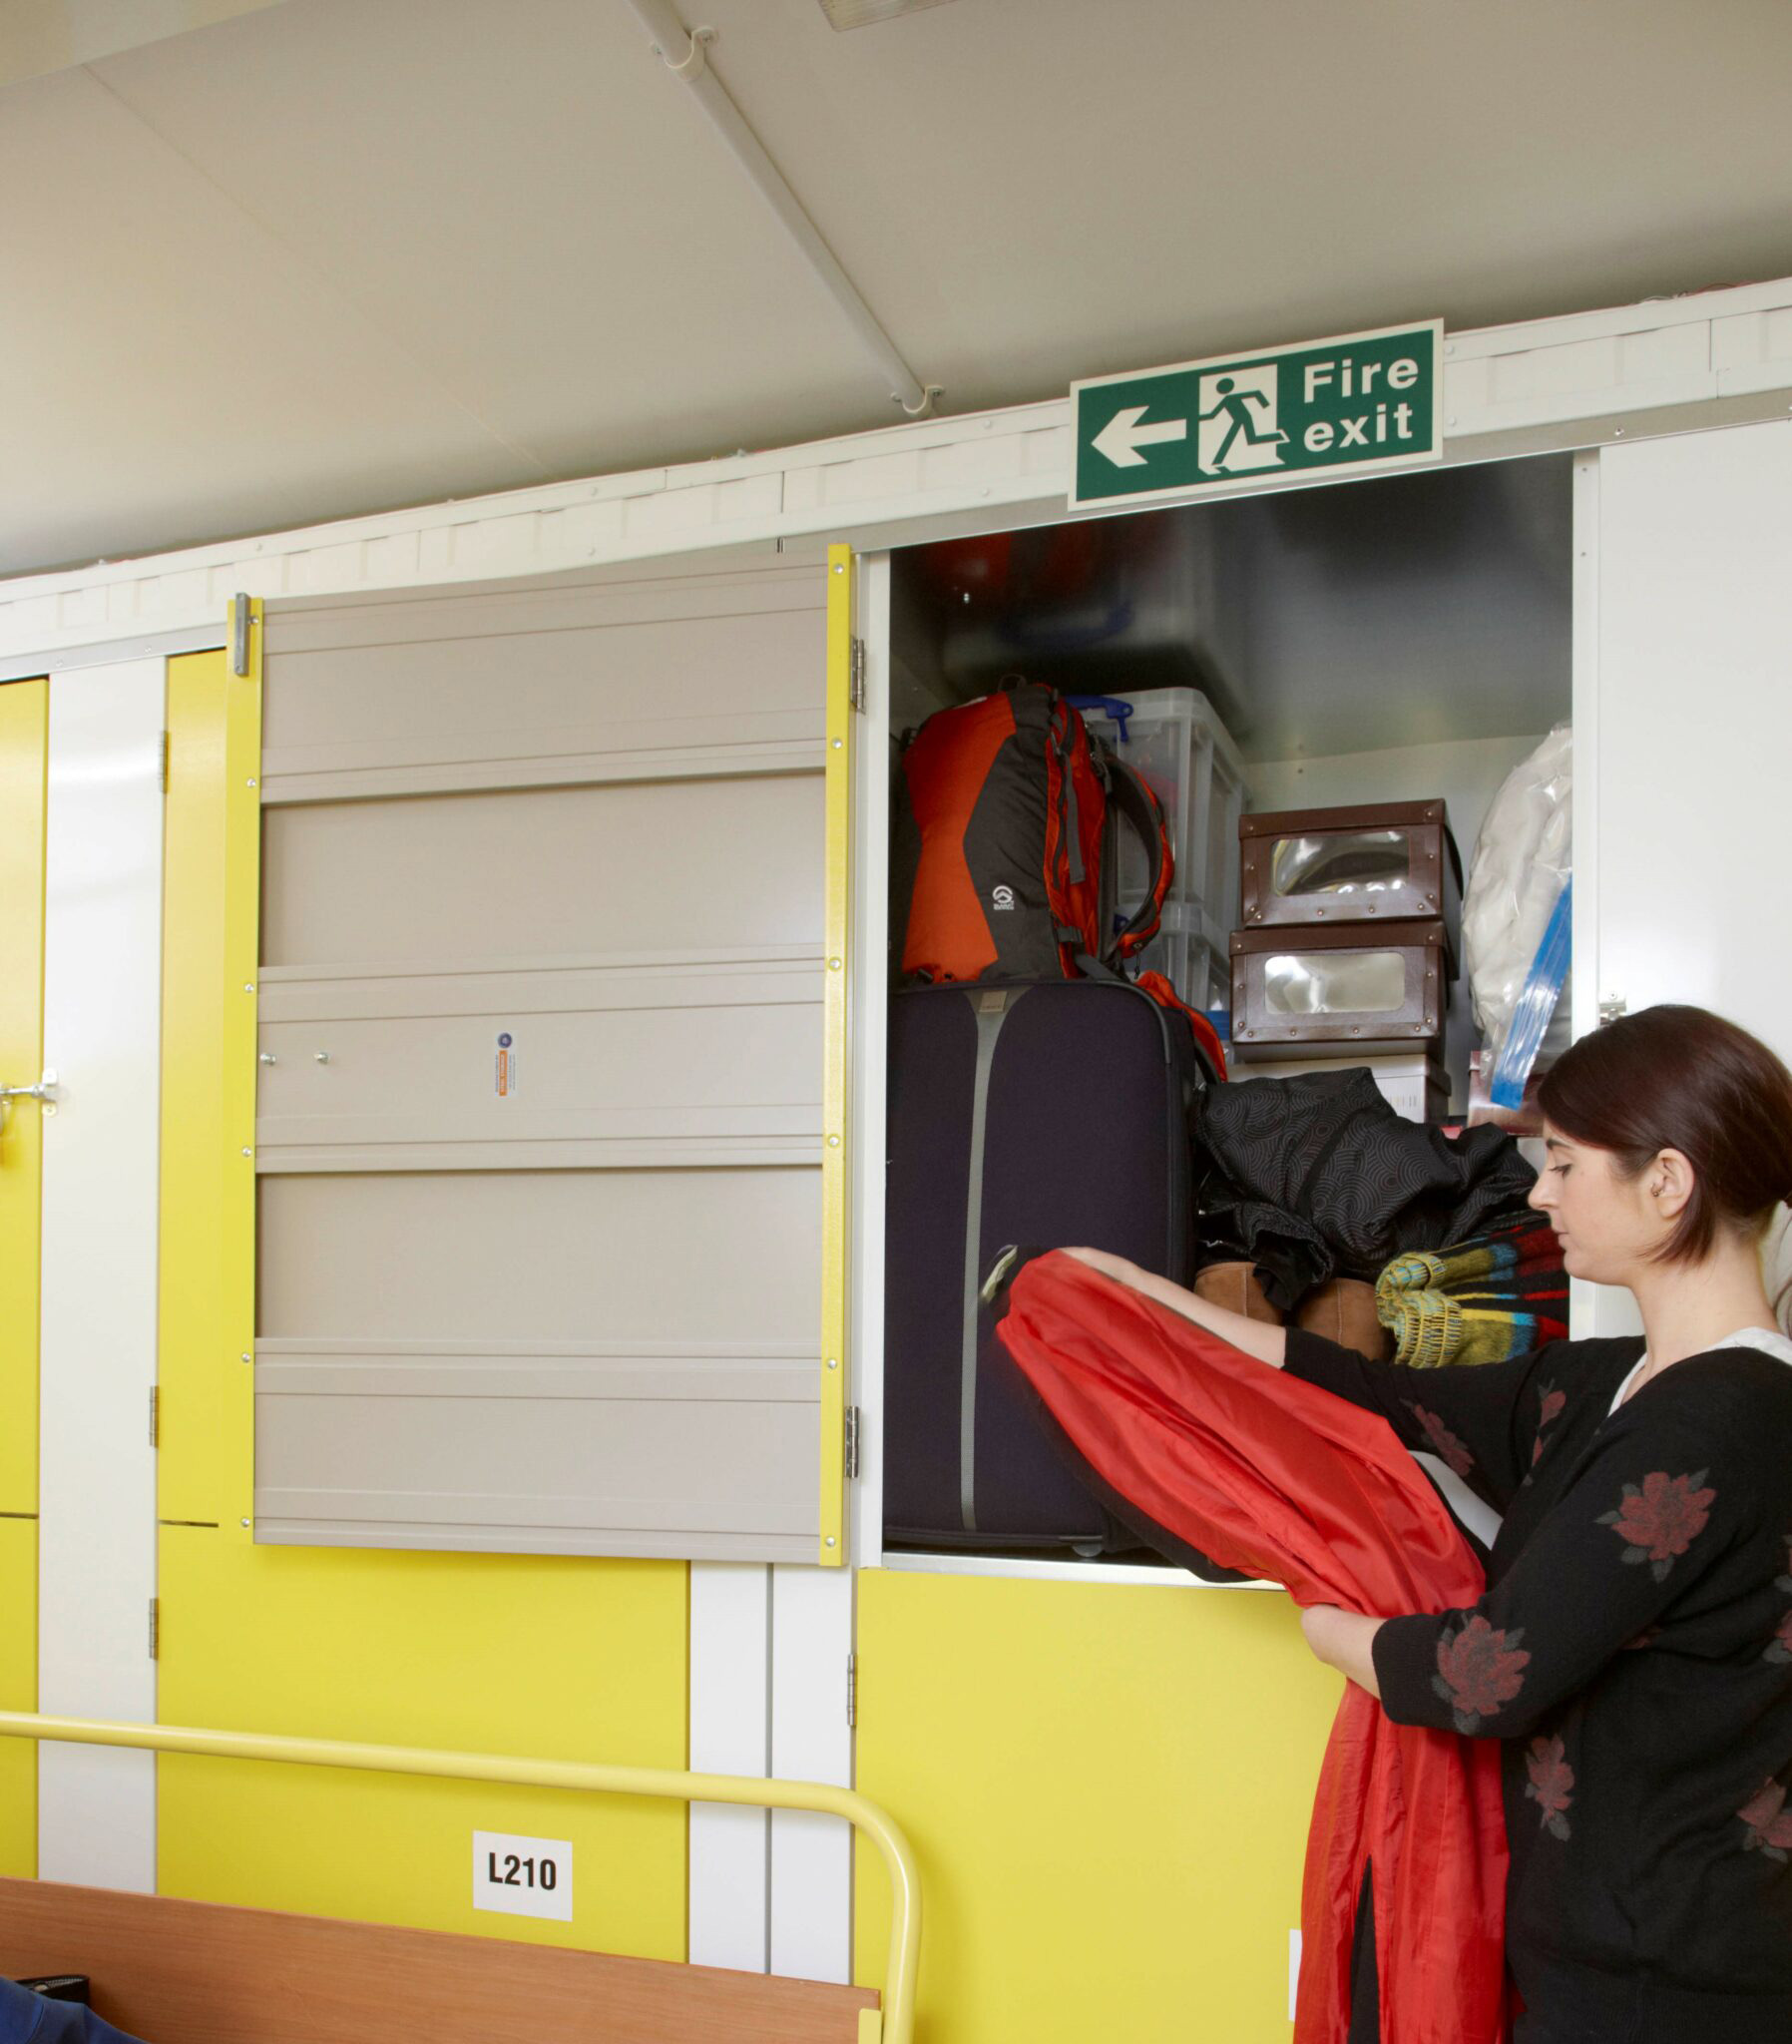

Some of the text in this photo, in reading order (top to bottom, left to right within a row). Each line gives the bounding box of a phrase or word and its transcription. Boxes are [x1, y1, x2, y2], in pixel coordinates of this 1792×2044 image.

[1303, 357, 1419, 403] Fire
[1303, 402, 1413, 452] exit
[489, 1851, 557, 1891] L210
